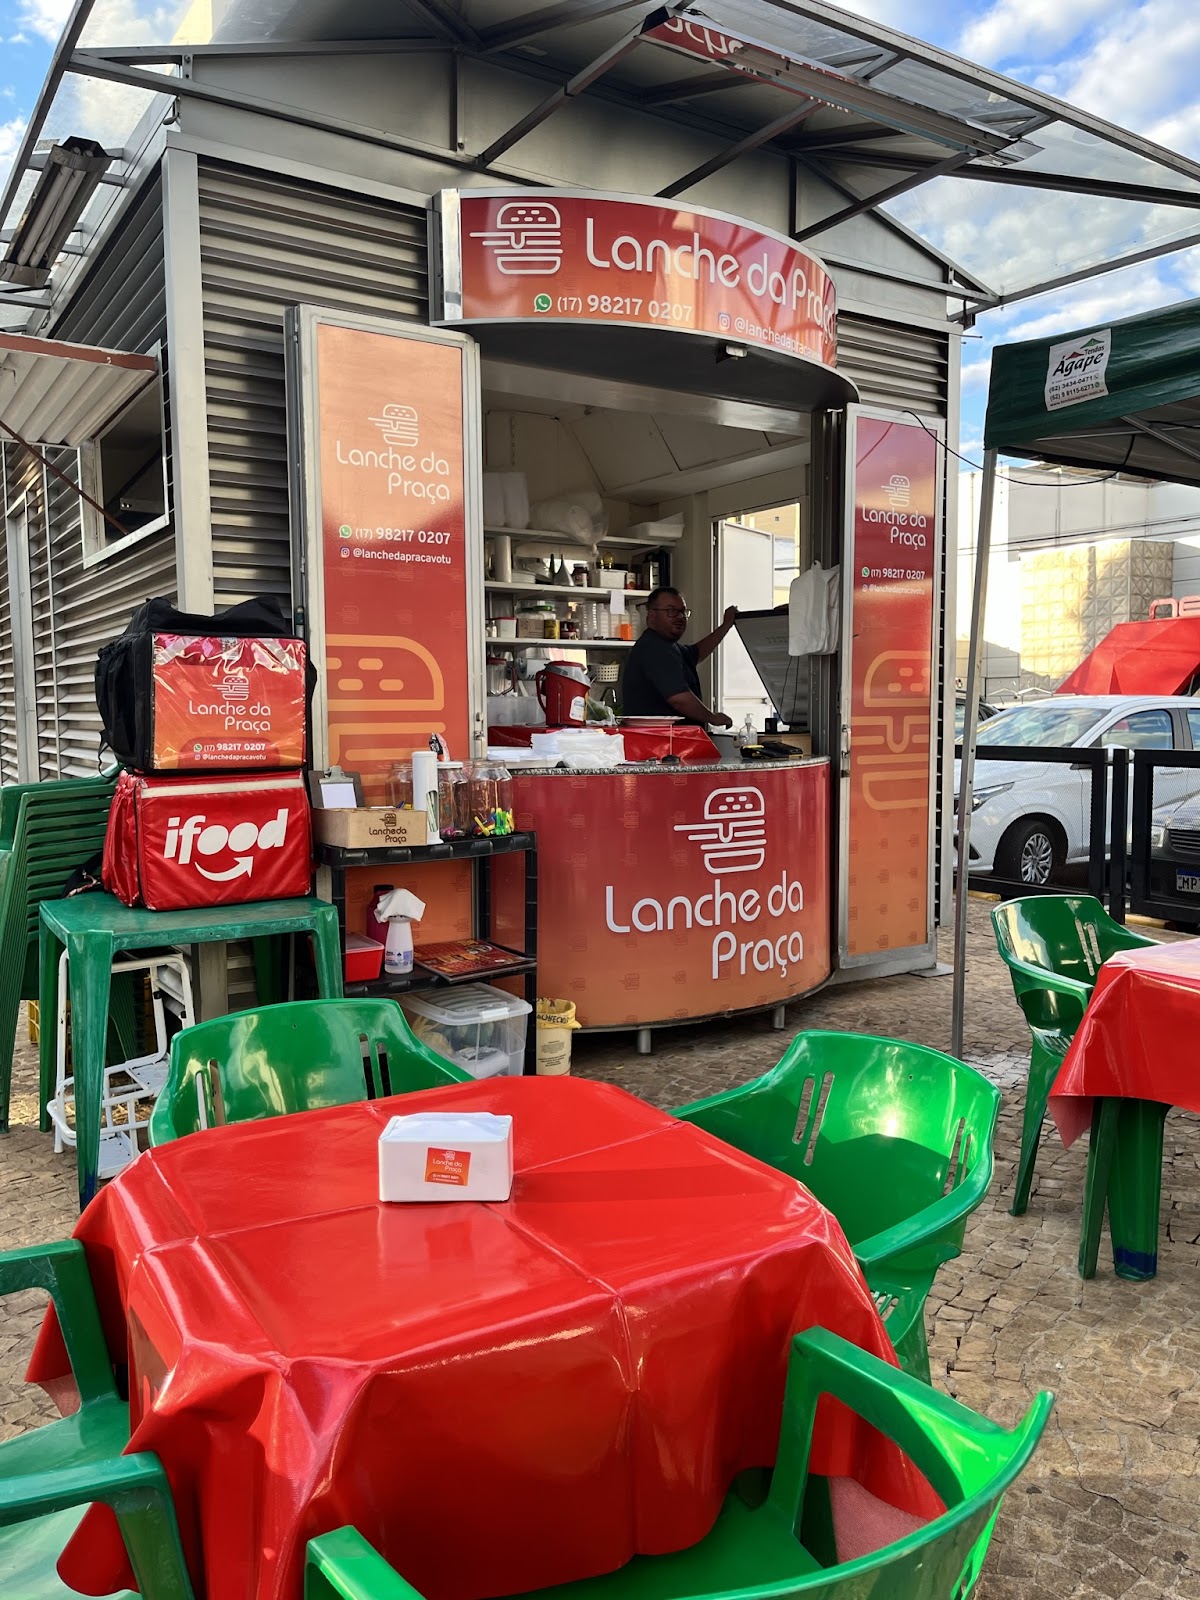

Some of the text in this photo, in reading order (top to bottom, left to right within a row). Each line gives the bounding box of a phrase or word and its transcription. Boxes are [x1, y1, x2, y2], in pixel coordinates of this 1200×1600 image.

[586, 217, 740, 288] Lanche
[747, 253, 787, 306] da
[556, 294, 693, 322] (17) 98217 0207
[1052, 352, 1104, 377] Ágape
[336, 440, 450, 476] Lanche da
[388, 472, 450, 505] Praça
[862, 503, 927, 528] Lanche da
[355, 527, 451, 545] (17) 98217 0207
[890, 526, 926, 550] Praça
[353, 547, 451, 564] @lanchedapracavotu
[870, 568, 926, 580] (17) 98217 0207
[188, 700, 271, 716] Lanche da
[224, 716, 271, 734] Praça
[203, 743, 266, 752] (17) 98217 0207
[202, 753, 267, 761] @lanchedapracavotu
[369, 827, 395, 835] Lanche
[385, 835, 406, 844] Praça
[1182, 876, 1200, 890] MP
[605, 869, 804, 933] Lanche da
[712, 930, 804, 979] Praça
